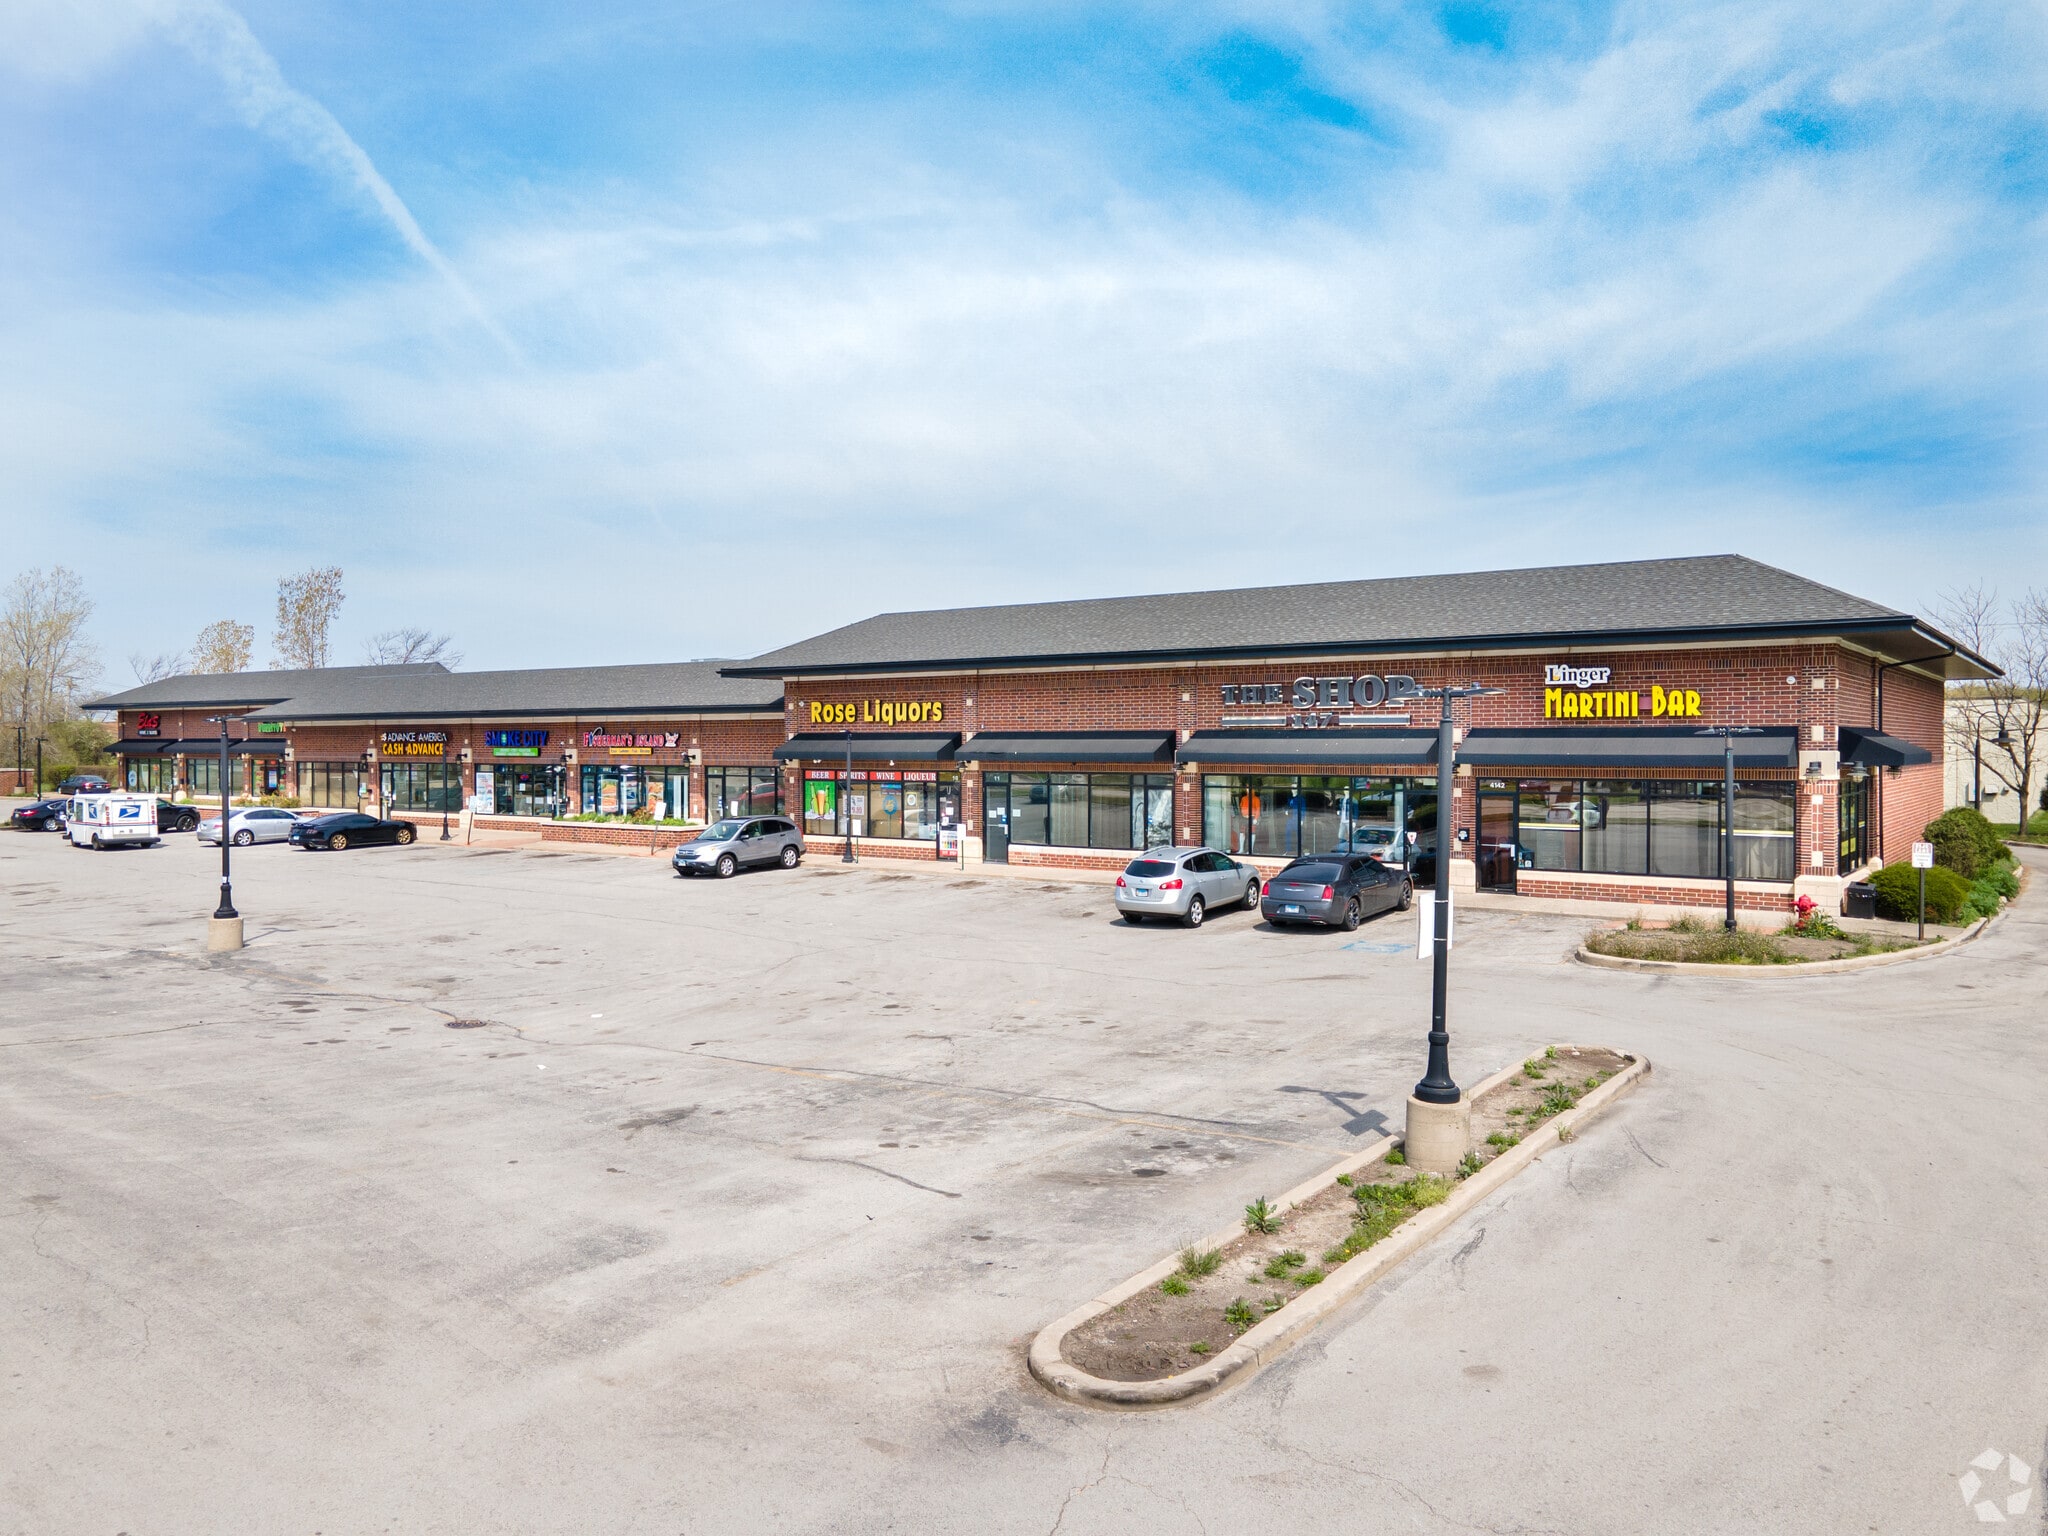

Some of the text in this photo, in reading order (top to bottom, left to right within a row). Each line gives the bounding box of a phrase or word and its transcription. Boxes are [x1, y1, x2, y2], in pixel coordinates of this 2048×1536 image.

[1547, 665, 1609, 686] Linger
[1221, 674, 1416, 709] THE SHOP
[1544, 685, 1703, 718] MARTINI BAR
[810, 699, 943, 726] Rose Liquors
[1291, 712, 1334, 728] 147
[387, 732, 447, 742] ADVANCE AMERICA
[484, 730, 548, 747] SMOKE CITY
[382, 742, 444, 755] CASH ADVANCE
[811, 771, 830, 779] BEER
[839, 771, 866, 780] SPRITS
[875, 772, 895, 780] WINE
[903, 772, 936, 781] LIQUEUR
